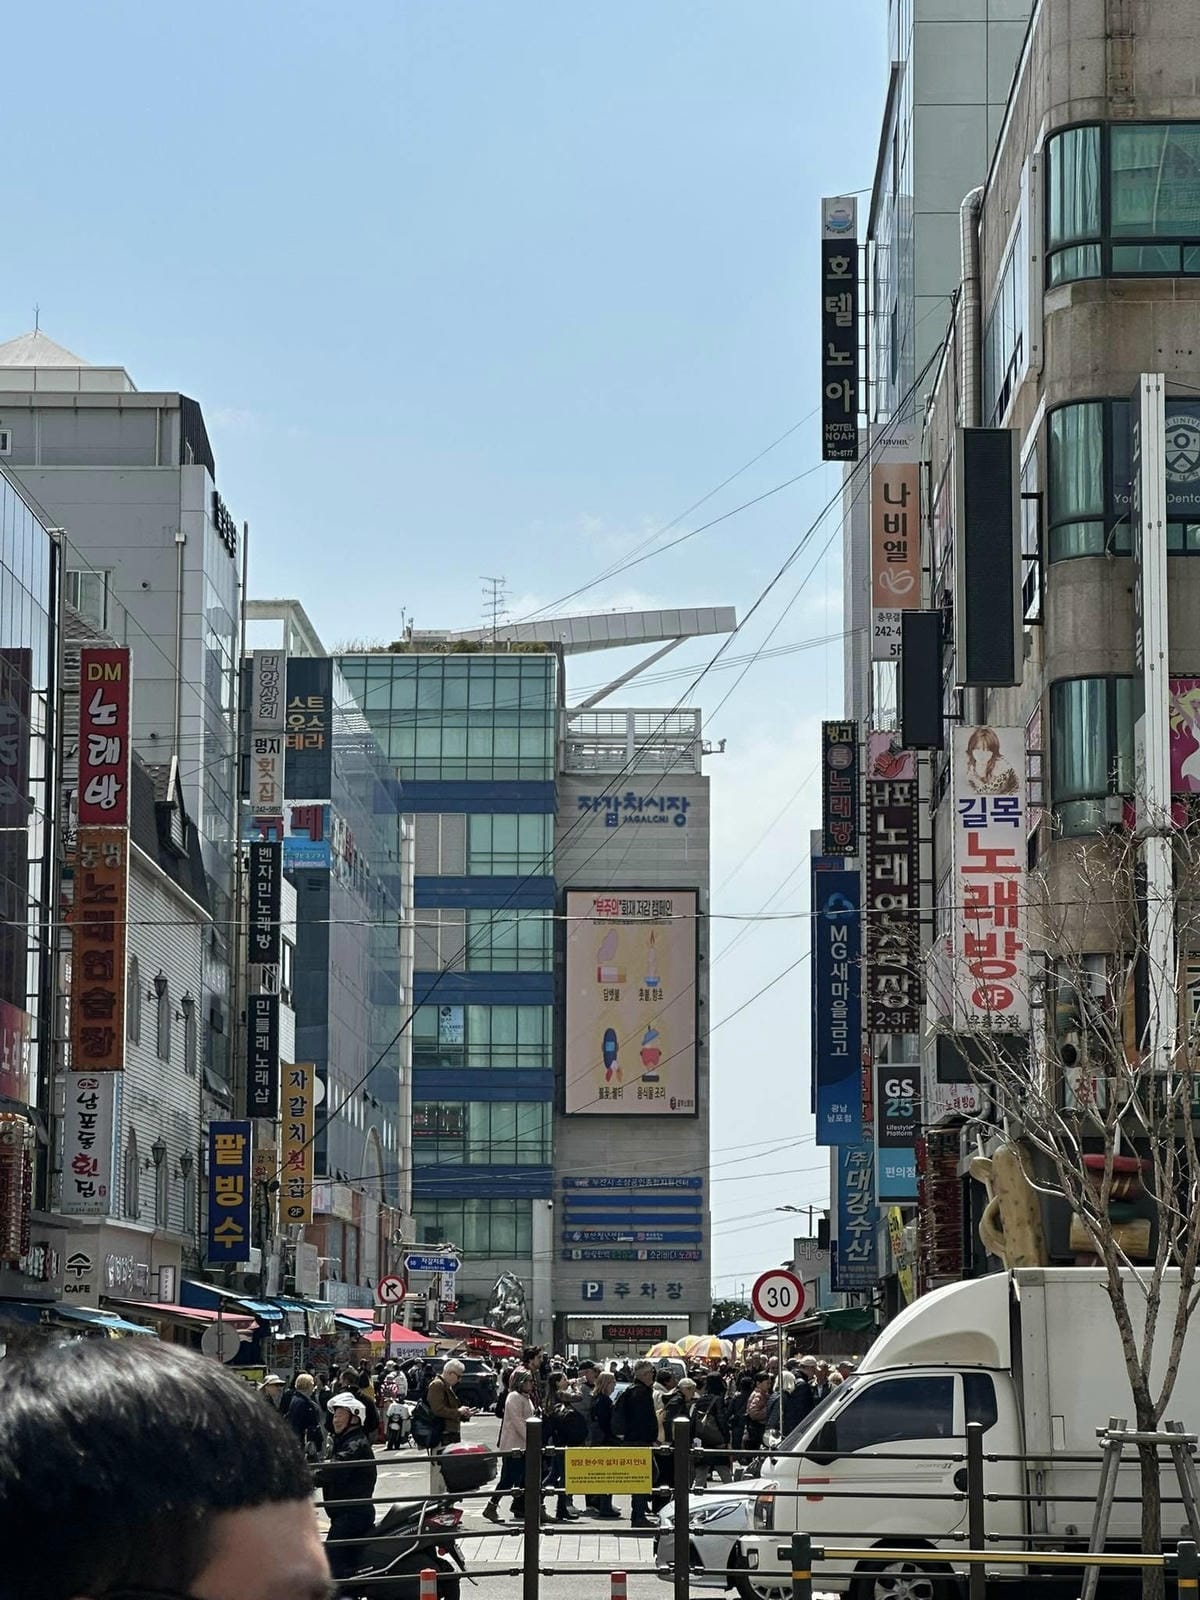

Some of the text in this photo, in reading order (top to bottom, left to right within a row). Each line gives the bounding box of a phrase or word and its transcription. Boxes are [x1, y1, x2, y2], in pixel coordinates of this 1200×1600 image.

[825, 255, 854, 413] 호텔노아
[825, 423, 855, 432] HOTEL
[825, 432, 856, 441] NOAH
[883, 482, 911, 563] 나비엘
[87, 663, 121, 681] DM
[259, 655, 279, 719] 밀양상회
[84, 688, 121, 809] 노래방
[255, 739, 280, 754] 명지
[258, 758, 276, 803] 횟집
[872, 782, 912, 807] 남포
[578, 792, 690, 827] 자갈치시장
[829, 770, 853, 845] 노래방
[958, 796, 1023, 829] 길목
[624, 815, 669, 824] JAGALCHI
[257, 847, 273, 949] 벤자민노래방
[960, 831, 1024, 980] 노래방
[254, 1000, 270, 1104] 민들레노래샵
[885, 1079, 915, 1098] GS
[886, 1098, 914, 1117] 25
[885, 1167, 916, 1178] 편의점
[213, 1134, 246, 1249] 팥빙수
[291, 1208, 303, 1216] 2F
[64, 1284, 91, 1293] CAFE
[587, 1282, 599, 1298] P
[614, 1282, 684, 1299] 주차장
[767, 1286, 791, 1308] 30
